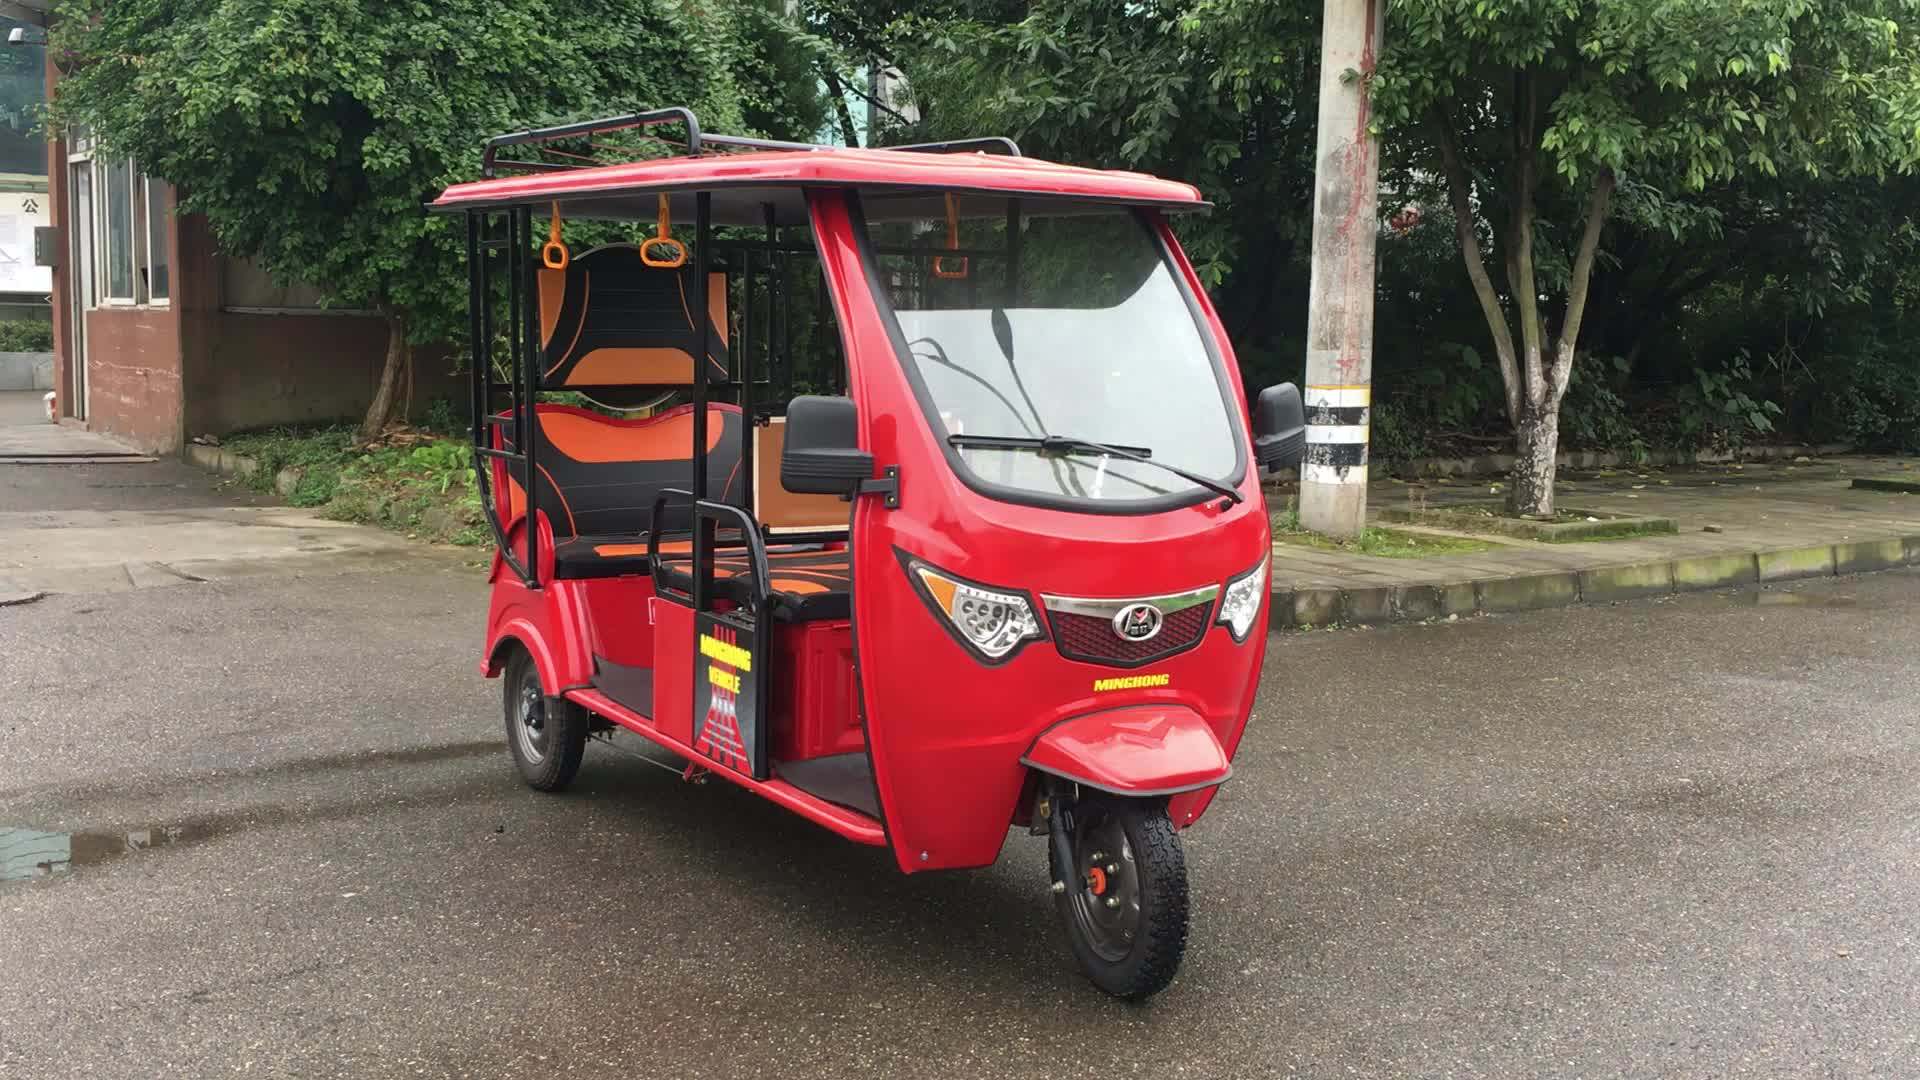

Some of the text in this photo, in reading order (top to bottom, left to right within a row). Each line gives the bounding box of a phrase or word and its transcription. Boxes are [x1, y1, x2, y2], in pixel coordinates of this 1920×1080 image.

[22, 198, 39, 214] 公
[709, 665, 740, 694] VEHICLE
[1094, 674, 1170, 691] MINGHONG
